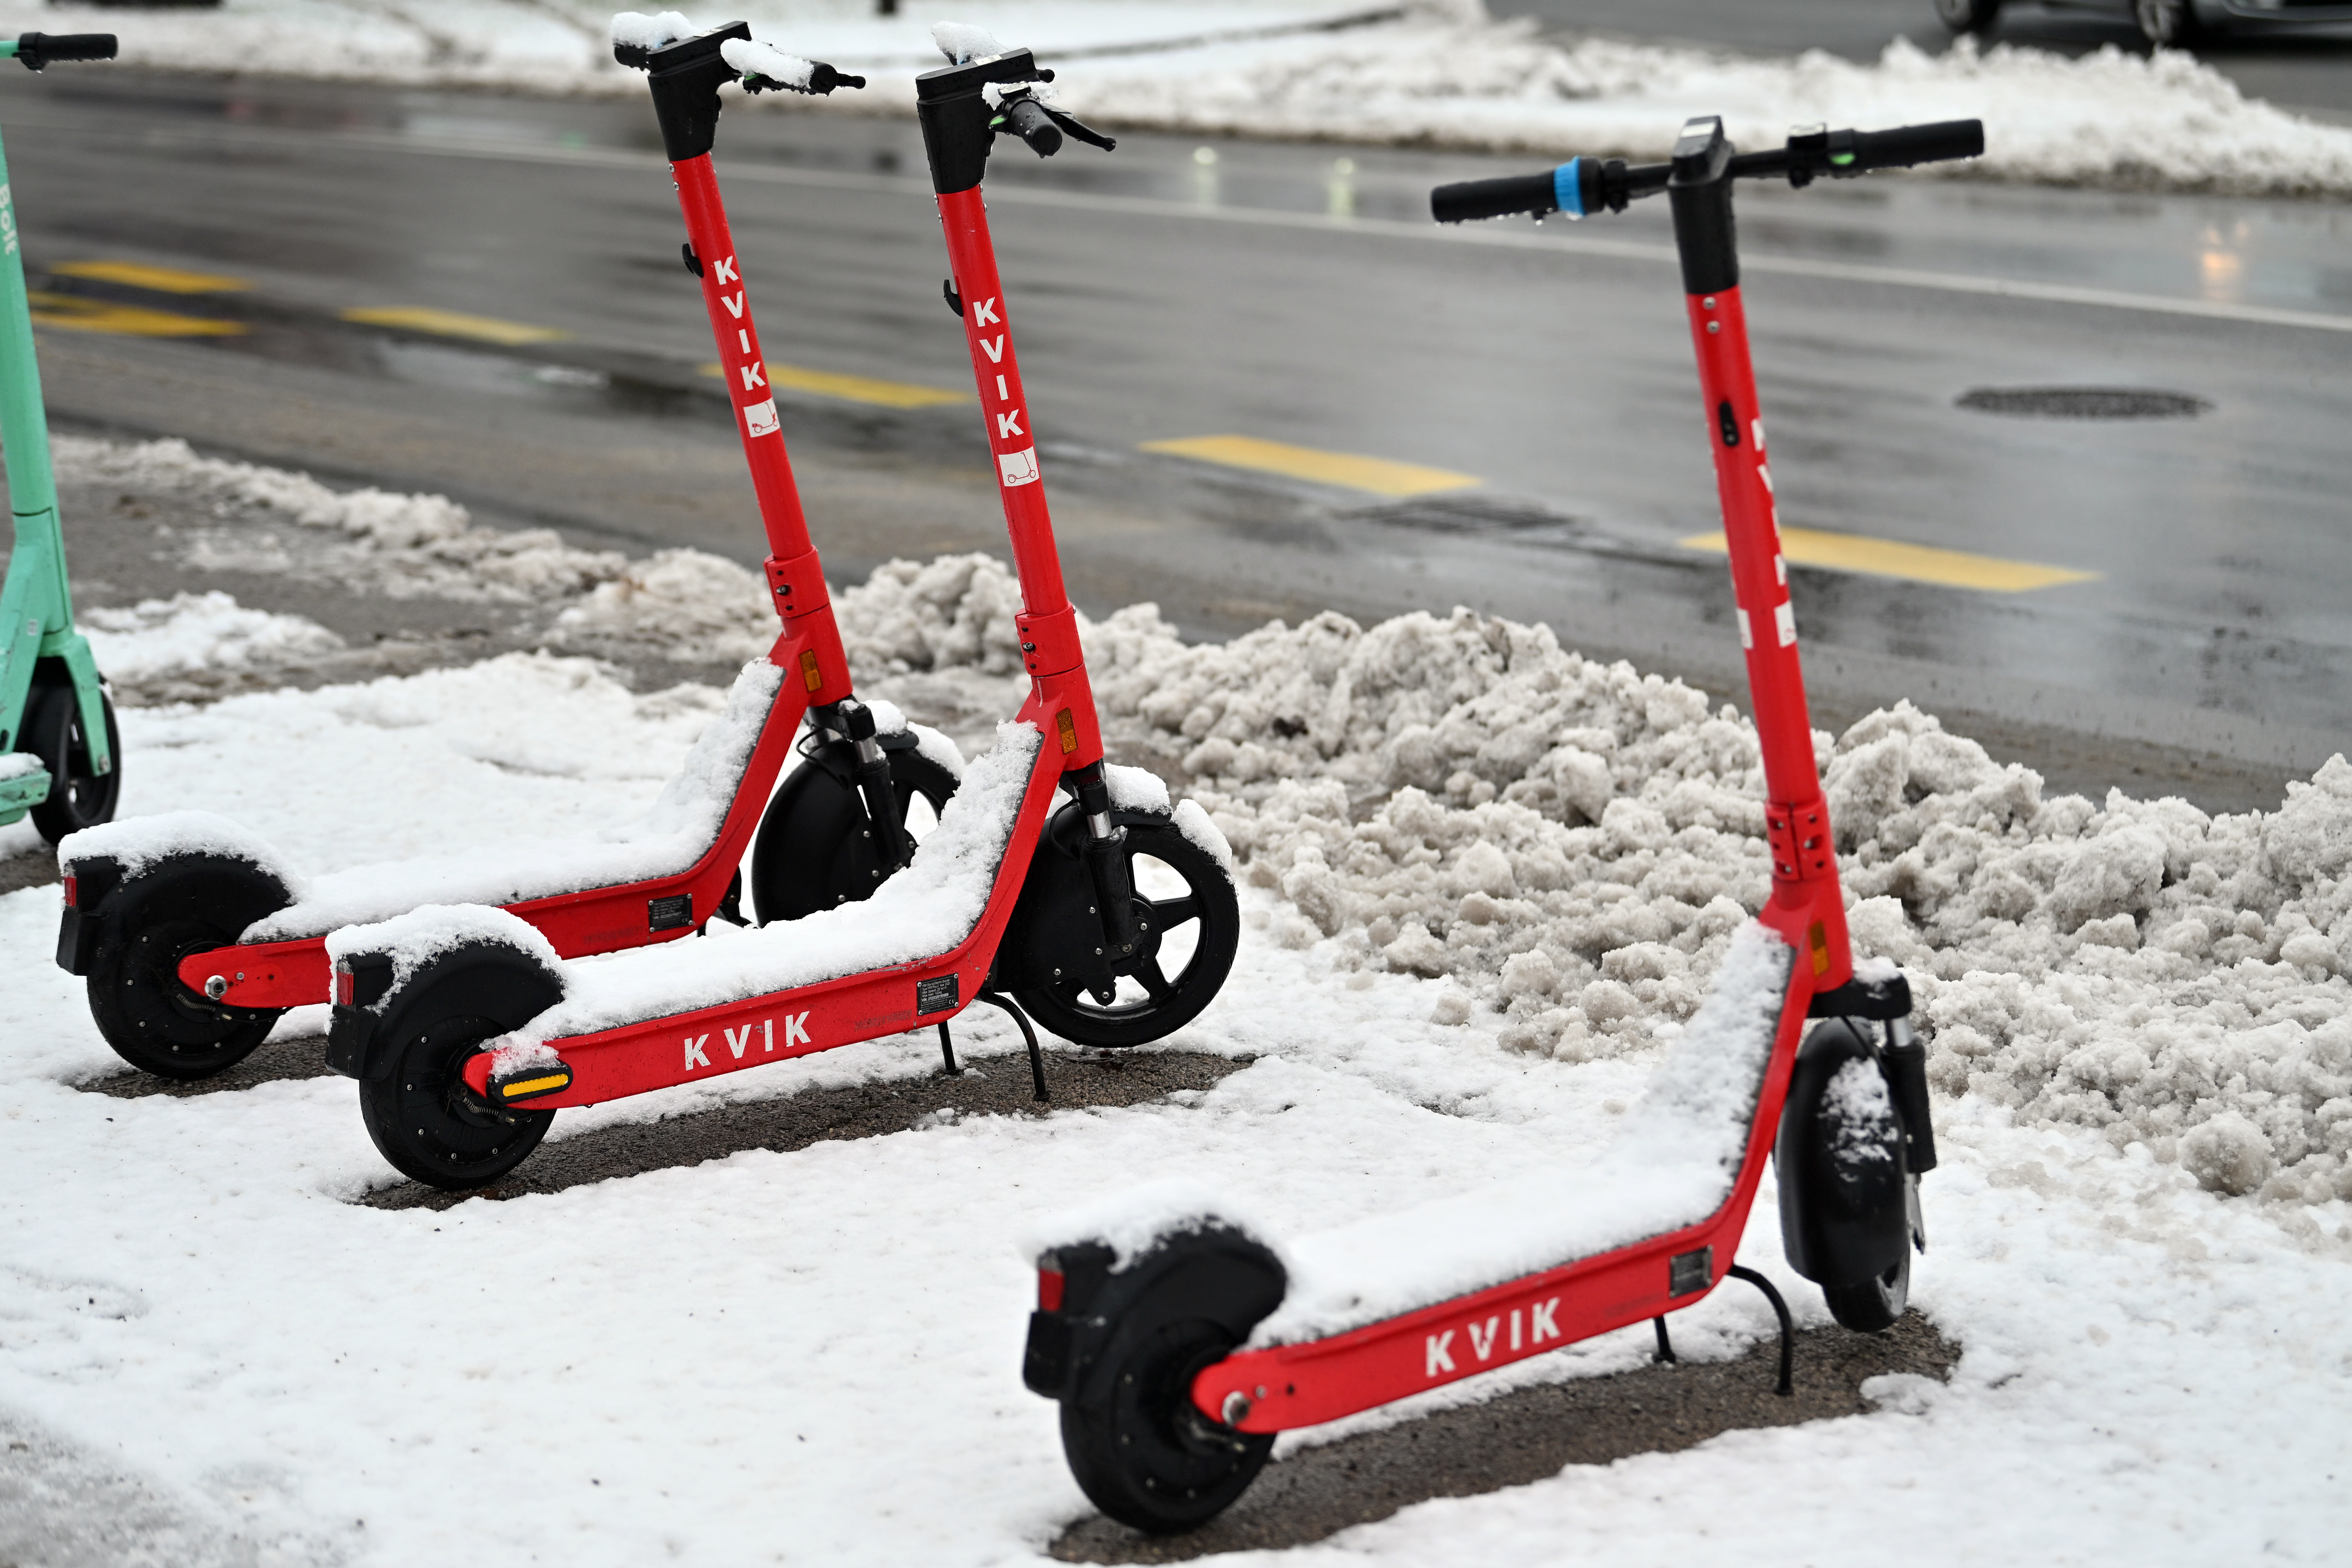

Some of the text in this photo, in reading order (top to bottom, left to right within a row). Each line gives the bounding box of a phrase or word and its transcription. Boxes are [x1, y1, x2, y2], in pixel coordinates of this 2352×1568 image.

[714, 255, 766, 391] KVIK
[973, 296, 1024, 439] KVIK
[684, 1011, 811, 1071] KVIK
[1426, 1297, 1560, 1377] KVIK
